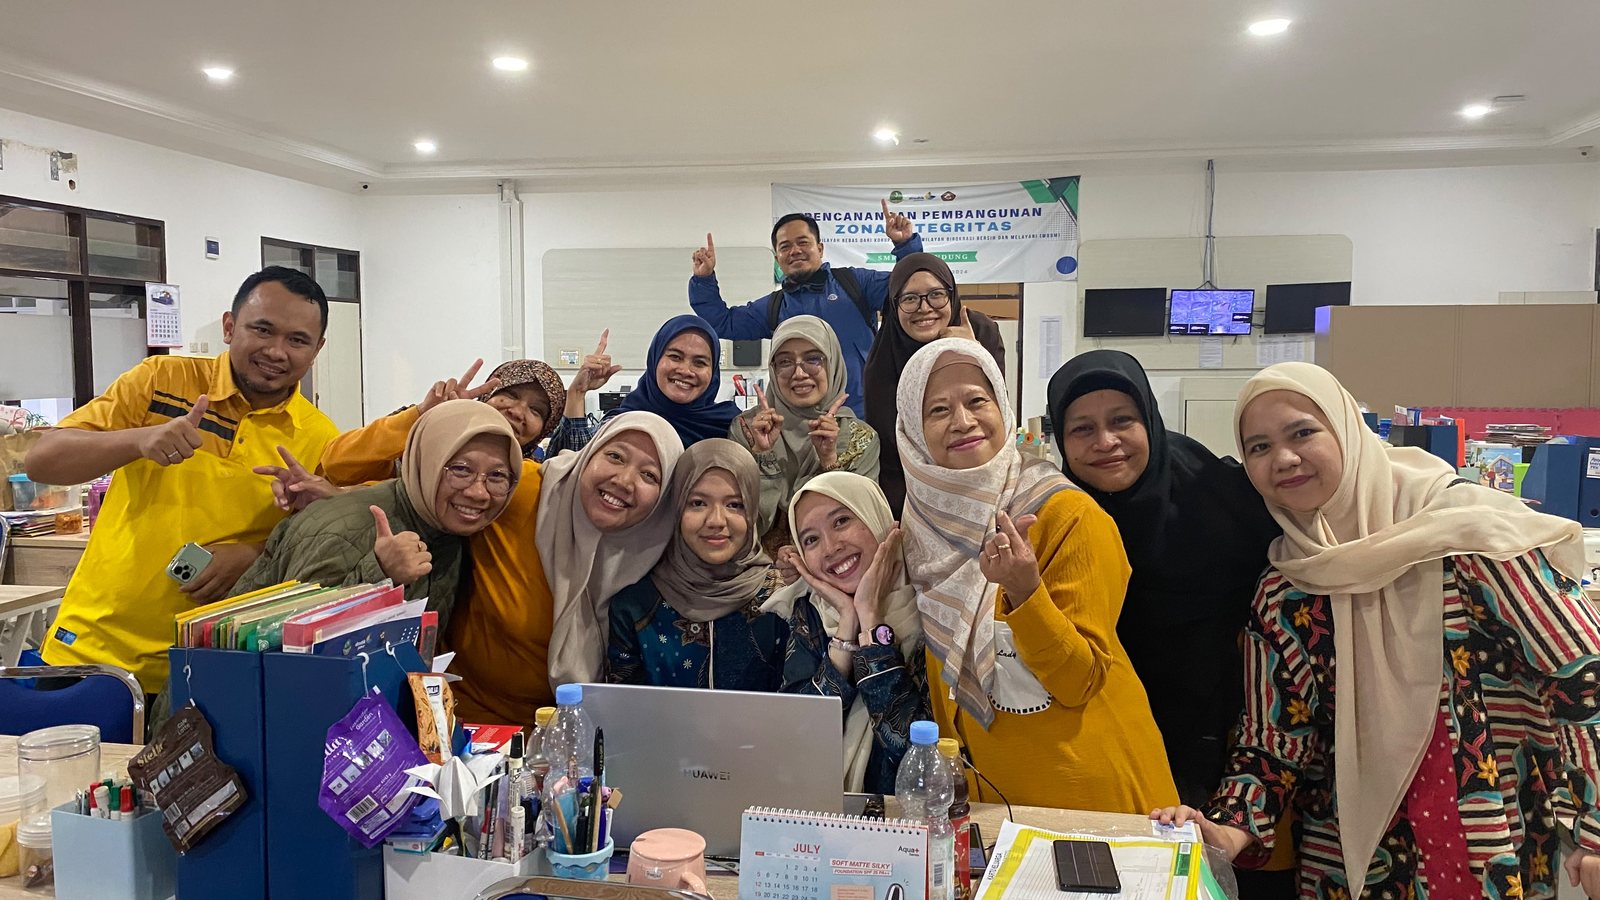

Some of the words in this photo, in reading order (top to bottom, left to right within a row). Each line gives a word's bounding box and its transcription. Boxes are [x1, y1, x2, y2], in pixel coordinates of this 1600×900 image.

[804, 211, 916, 221] PENCANANAN
[923, 207, 1042, 219] PEMBANGUNAN
[835, 224, 886, 234] ZONA
[915, 221, 1012, 233] TEGRITAS
[997, 649, 1017, 659] Lady
[355, 712, 374, 730] Garden
[683, 768, 731, 781] HUAWEI
[793, 843, 821, 854] JULY
